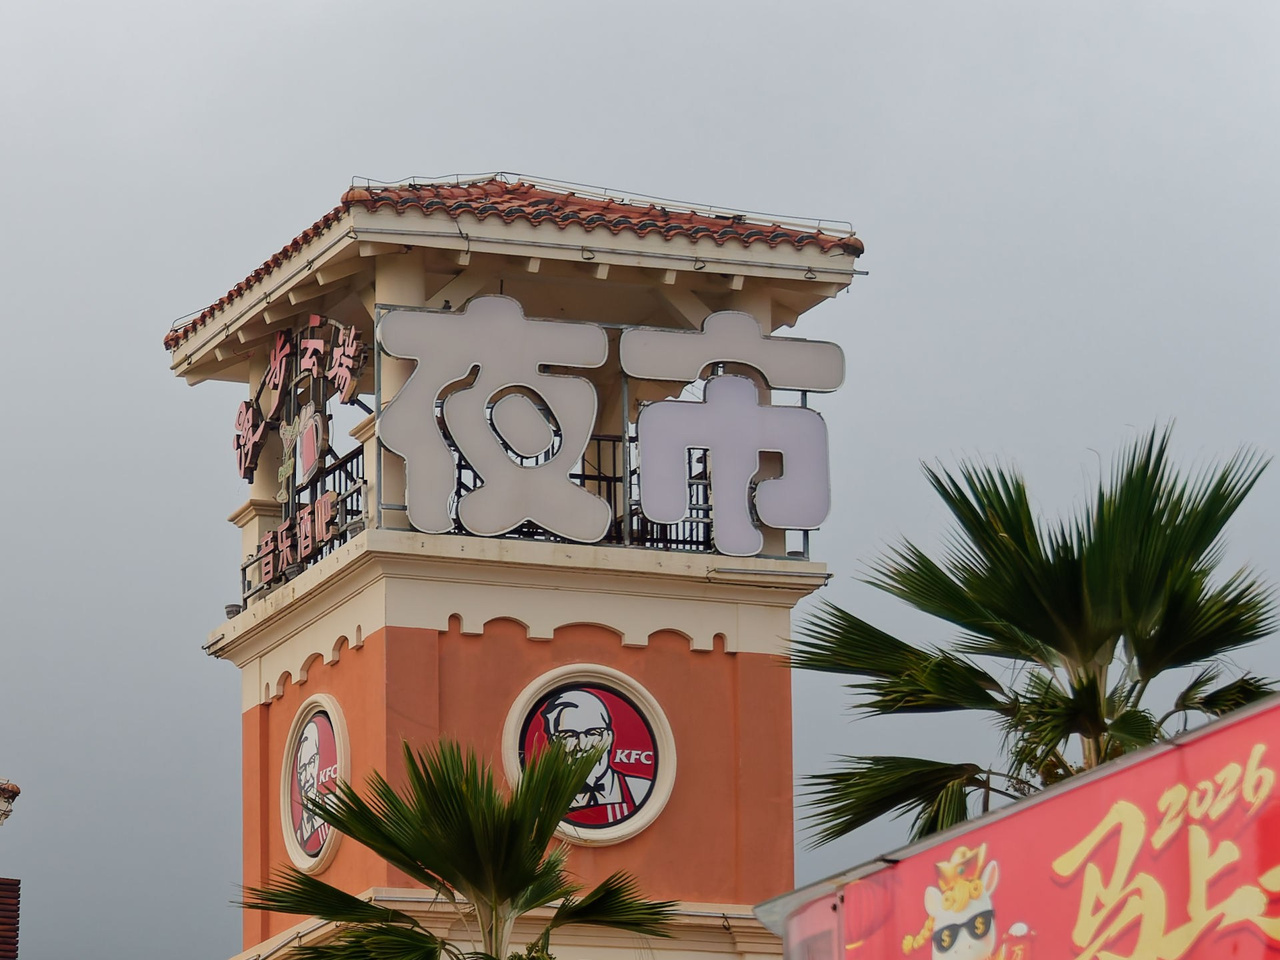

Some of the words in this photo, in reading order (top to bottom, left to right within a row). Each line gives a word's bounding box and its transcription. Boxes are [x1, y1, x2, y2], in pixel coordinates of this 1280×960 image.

[376, 294, 846, 557] 夜市
[260, 490, 338, 584] 音乐酒吧
[318, 764, 338, 785] KFC
[614, 748, 653, 765] KFC
[1151, 744, 1275, 850] 2026
